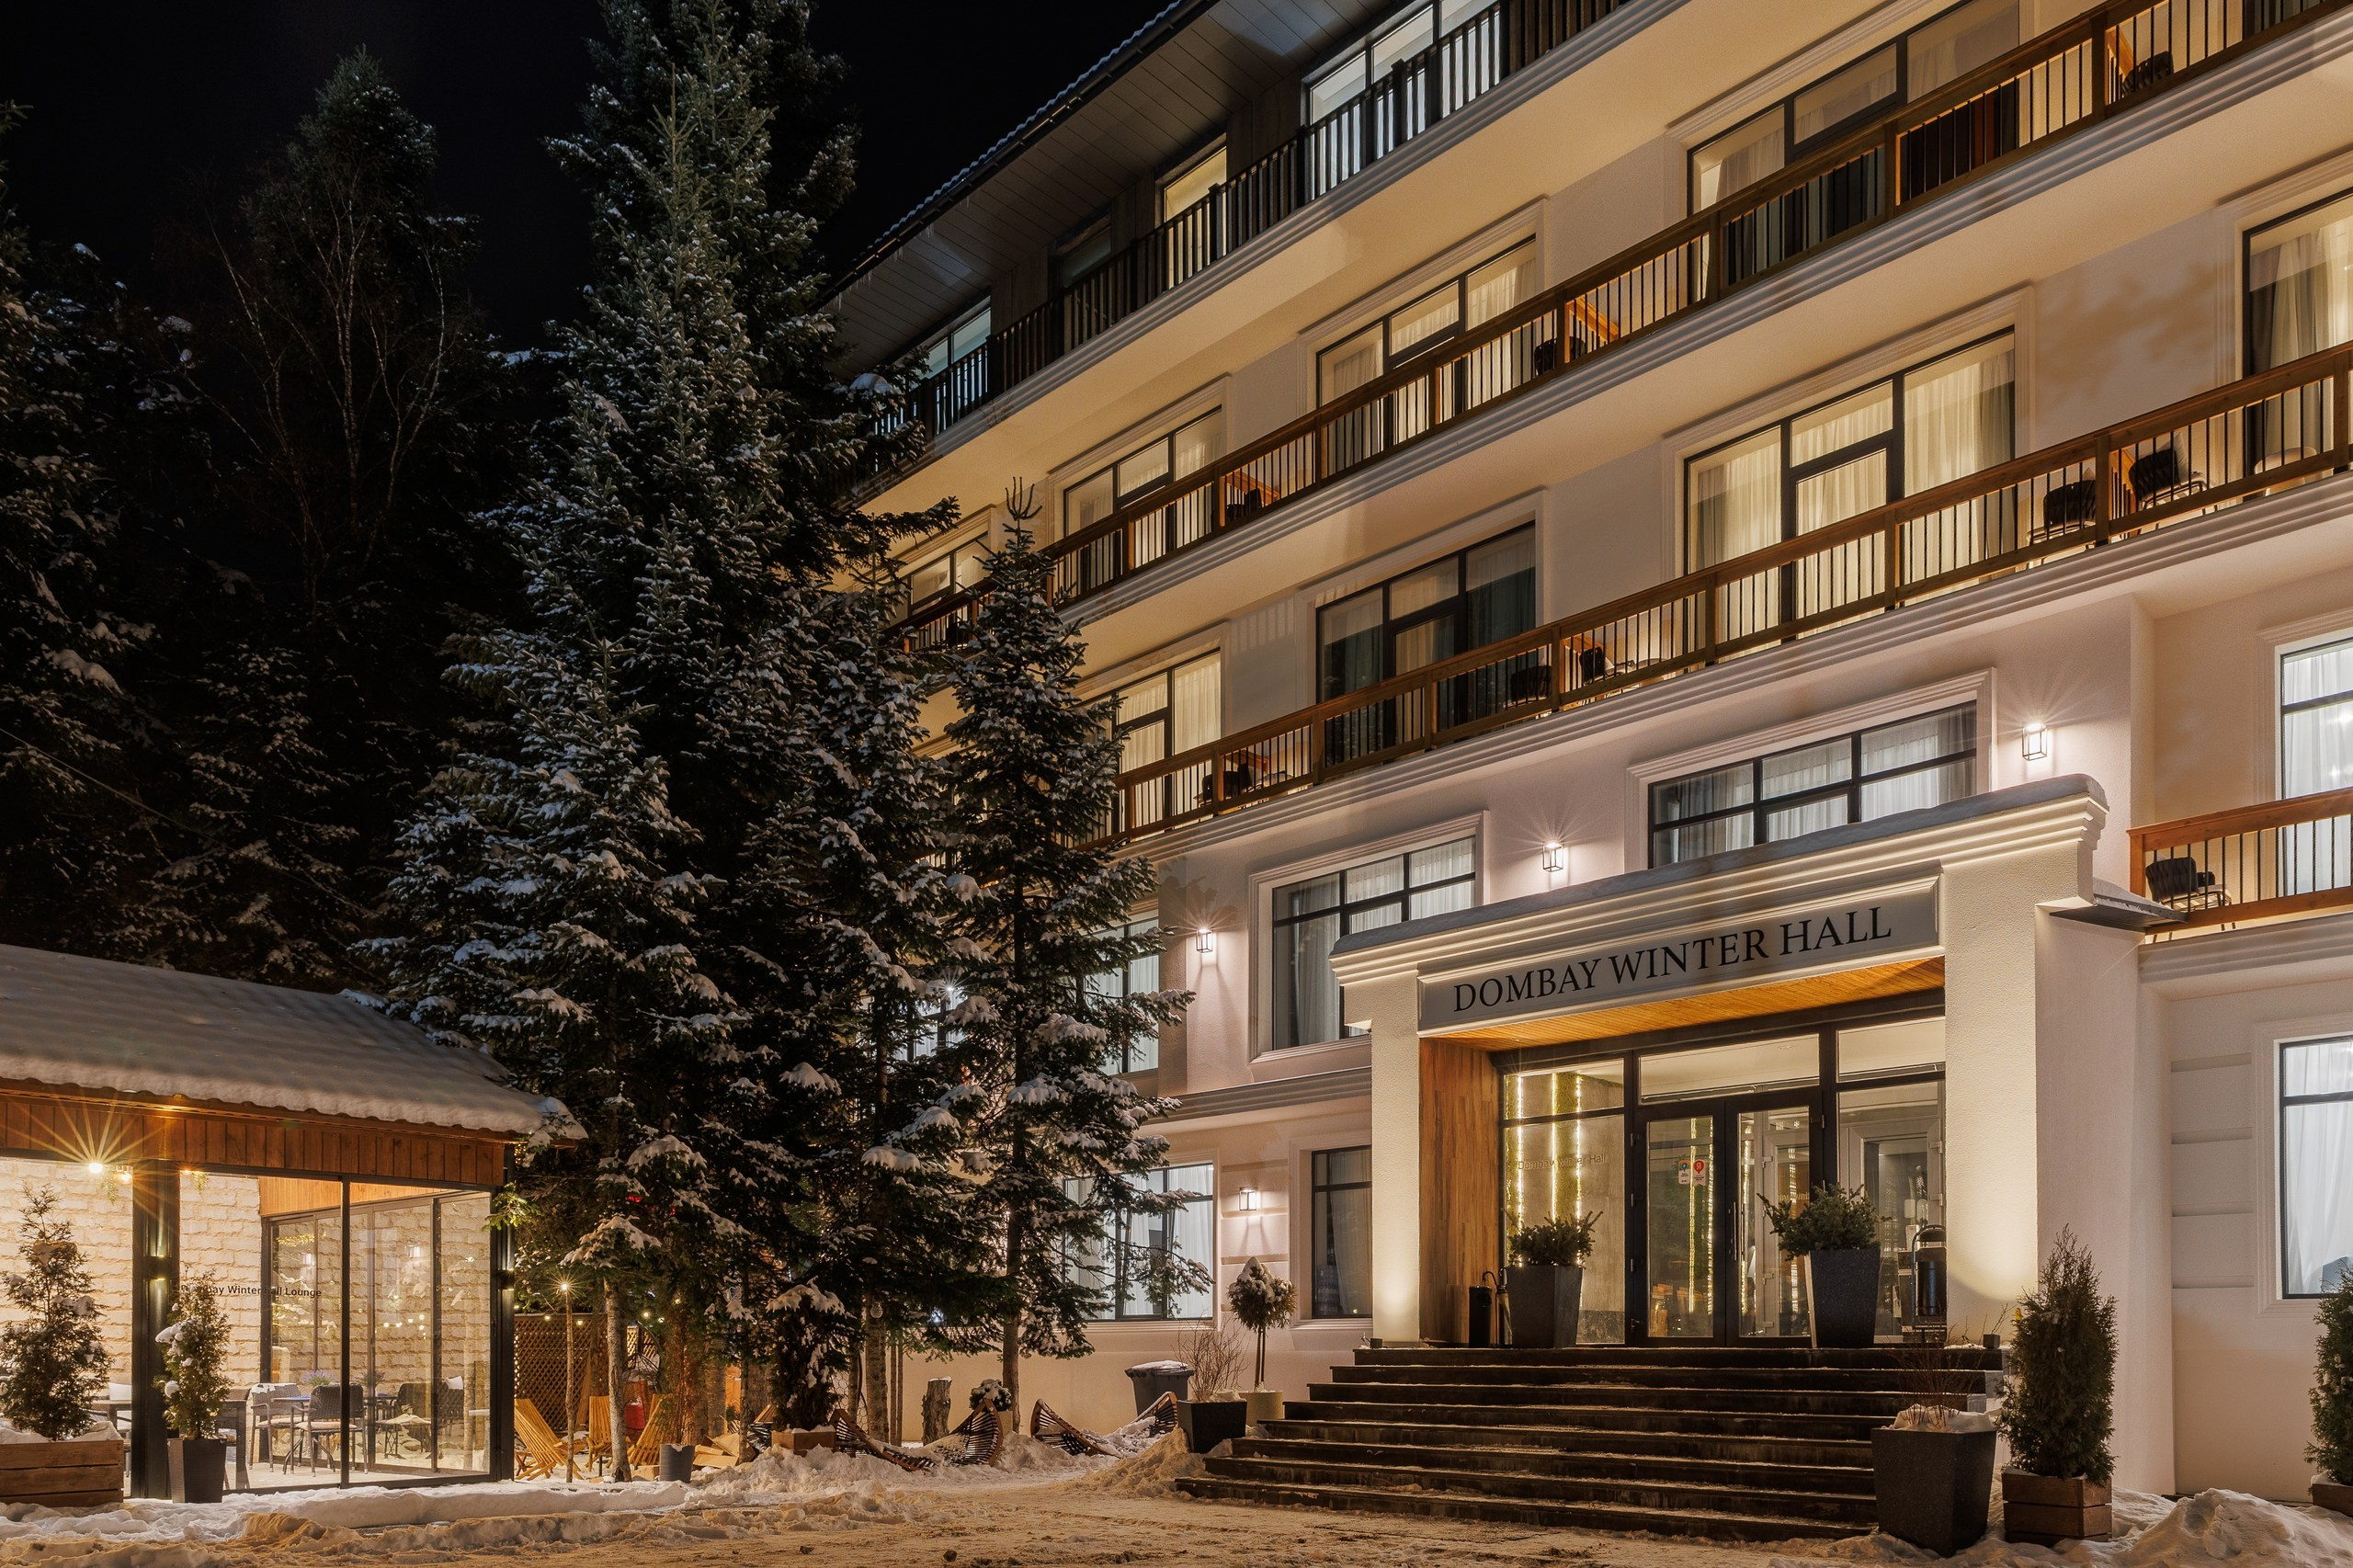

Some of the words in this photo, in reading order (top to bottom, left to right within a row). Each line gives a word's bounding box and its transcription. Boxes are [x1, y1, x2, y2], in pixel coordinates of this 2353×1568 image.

[1453, 958, 1601, 1013] DOMBAY
[1608, 928, 1768, 984] WINTER
[1779, 906, 1892, 956] HALL
[1589, 1153, 1606, 1165] Hall
[228, 1285, 262, 1295] Winter
[285, 1287, 322, 1298] Lounge
